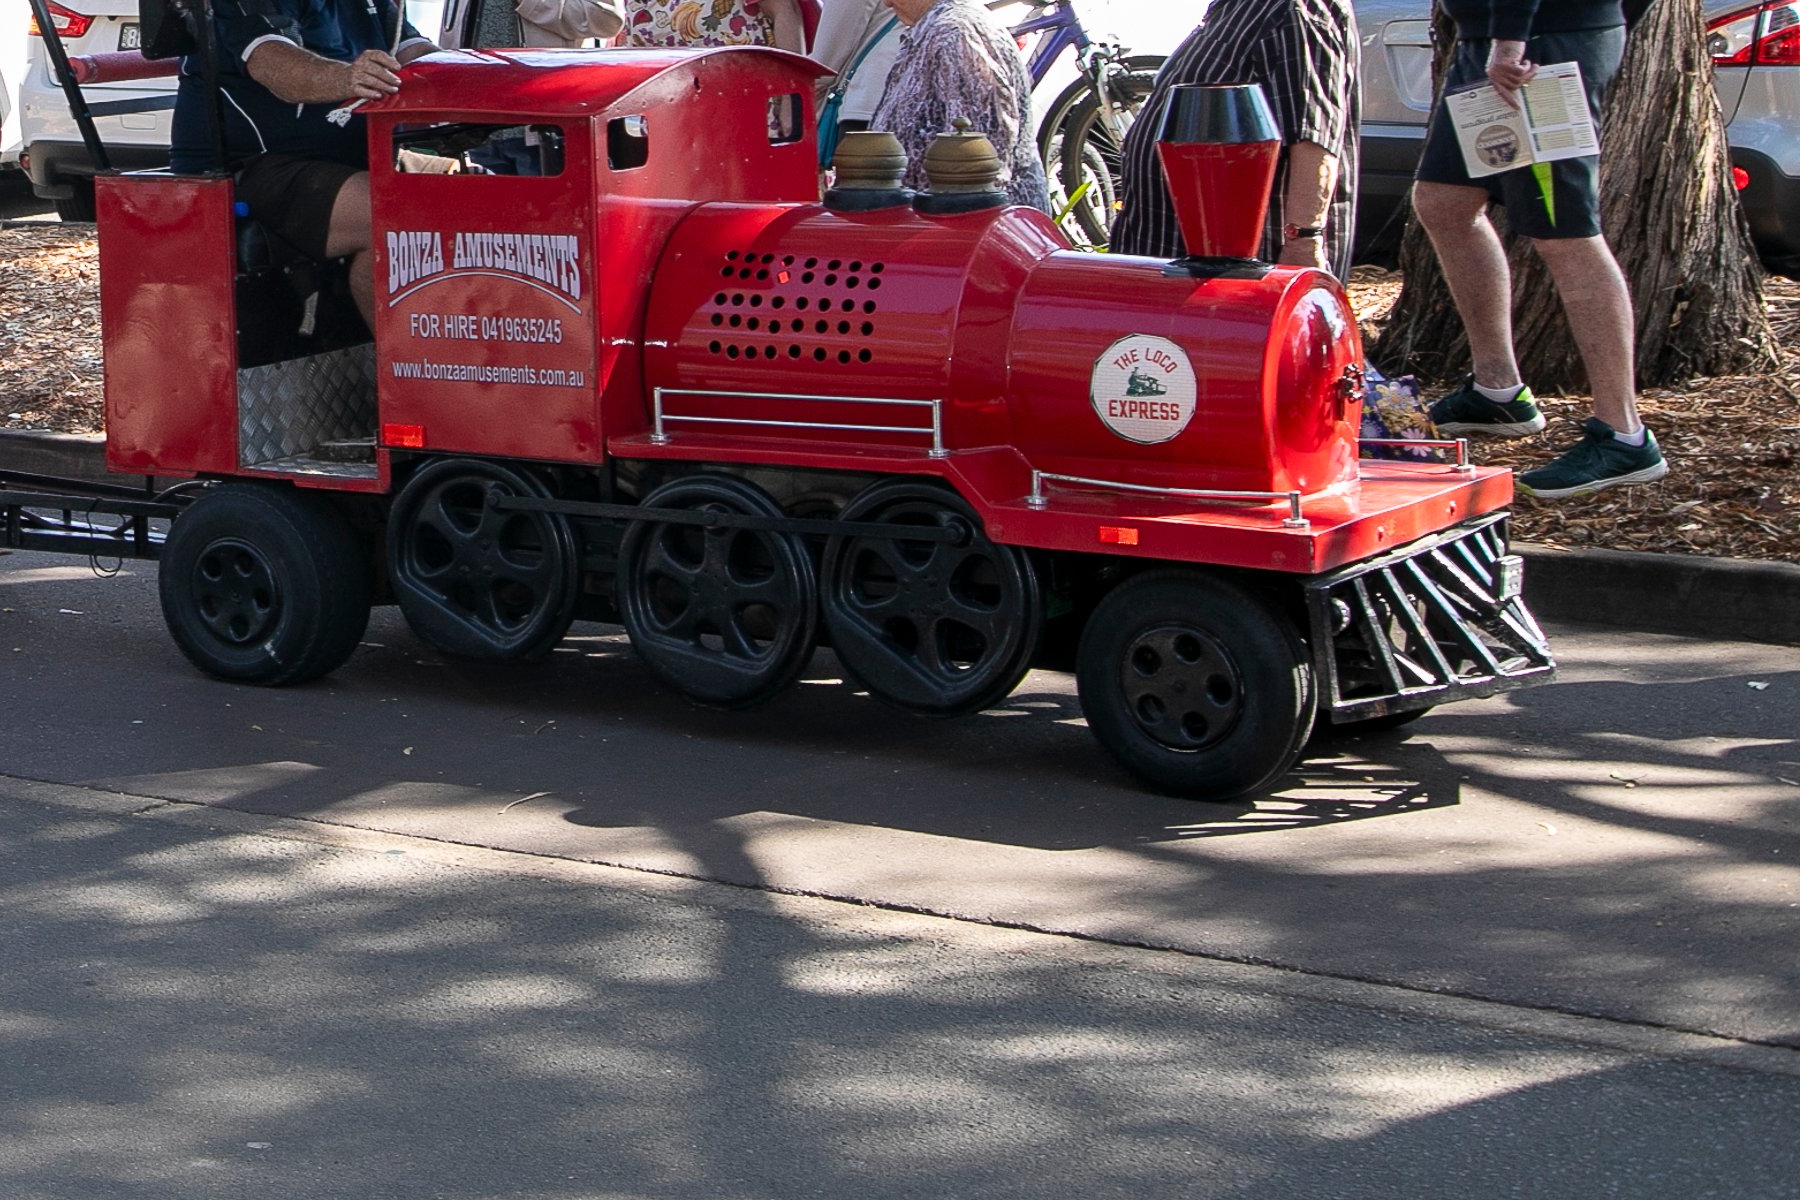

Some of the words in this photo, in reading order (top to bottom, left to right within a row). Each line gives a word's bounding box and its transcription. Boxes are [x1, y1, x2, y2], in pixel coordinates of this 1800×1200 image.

[386, 231, 444, 294] BONZA
[453, 232, 581, 300] AMUSEMENTS
[410, 313, 441, 338] FOR
[444, 314, 478, 339] HIRE
[481, 317, 562, 343] 0419635245
[392, 358, 584, 386] www.bonzaamusements.com.au
[1113, 349, 1139, 370] THE
[1145, 347, 1178, 373] LOCO
[1108, 400, 1180, 420] EXPRESS
